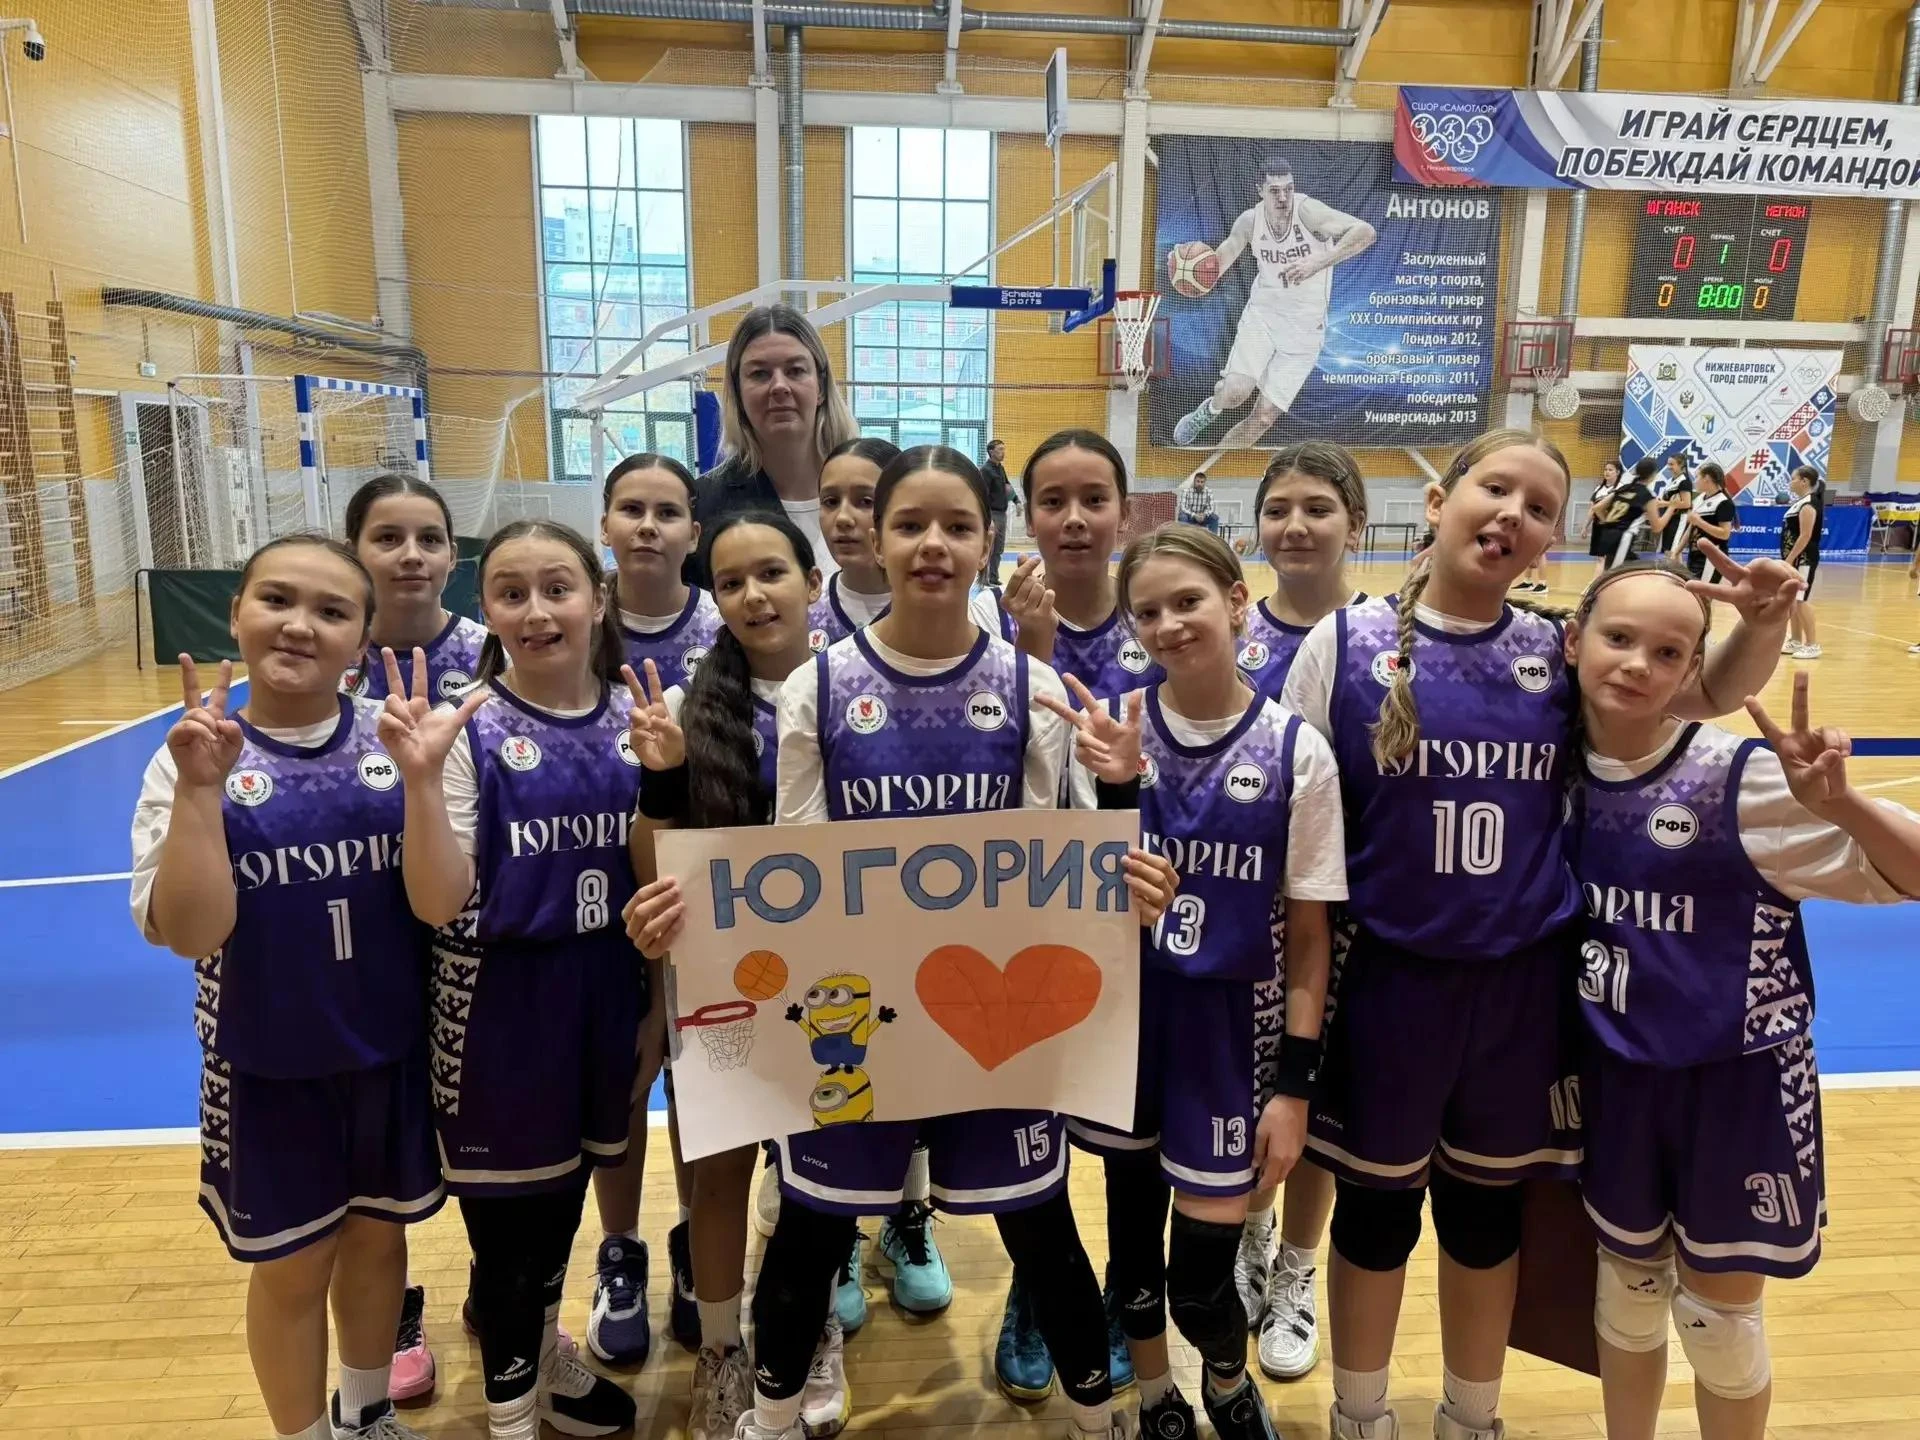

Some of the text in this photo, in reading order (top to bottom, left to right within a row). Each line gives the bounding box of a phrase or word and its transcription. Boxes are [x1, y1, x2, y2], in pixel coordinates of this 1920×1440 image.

[1411, 101, 1498, 114] СШОР «САМОТЛОР»
[1620, 106, 1894, 152] ИГРАЙ СЕРДЦЕМ,
[1558, 145, 1752, 184] ПОБЕЖДАЙ
[1646, 200, 1701, 217] ЮГАНСК
[1663, 225, 1685, 234] СЧЕТ
[1760, 228, 1783, 237] СЧЕТ
[1260, 243, 1312, 265] RUSSIA
[1402, 252, 1487, 268] Заслуженный
[1672, 235, 1696, 270] 0
[1719, 243, 1729, 264] 1
[1768, 238, 1792, 272] 0
[1395, 274, 1484, 288] мастер спорта,
[1001, 298, 1042, 306] Sports
[1369, 292, 1484, 309] бронзовый призер
[1657, 283, 1675, 307] 0
[1698, 284, 1743, 309] 8:00
[1753, 285, 1769, 309] 0
[1374, 311, 1459, 325] Олимпийских
[1462, 315, 1483, 328] игр
[1401, 332, 1481, 347] Лондон 2012,
[1366, 352, 1481, 368] бронзовый призер
[1705, 362, 1776, 374] НИЖНЕВАРТОВСК
[1322, 371, 1479, 386] чемпионата Европы 2011,
[1709, 374, 1769, 385] ГОРОД СПОРТА
[1406, 391, 1479, 407] победитель
[1364, 410, 1477, 427] Универсиады 2013
[1122, 651, 1147, 661] РФБ
[1518, 665, 1548, 678] РФБ
[971, 703, 1002, 717] РФБ
[364, 764, 393, 777] РФБ
[1230, 776, 1261, 789] РФБ
[840, 772, 1011, 815] ЮГОРИЯ
[1655, 819, 1692, 834] РФБ
[1432, 799, 1505, 876] 10
[1142, 831, 1264, 882] ГОРИЯ
[576, 868, 609, 934] 8
[1582, 881, 1697, 934] ОРИЯ
[327, 897, 353, 961] 1
[1577, 939, 1630, 1015] 31
[1549, 1074, 1582, 1130] 10
[1012, 1121, 1051, 1168] 15
[1211, 1115, 1248, 1158] 13
[1743, 1172, 1801, 1228] 31
[493, 1364, 535, 1381] DEMIX
